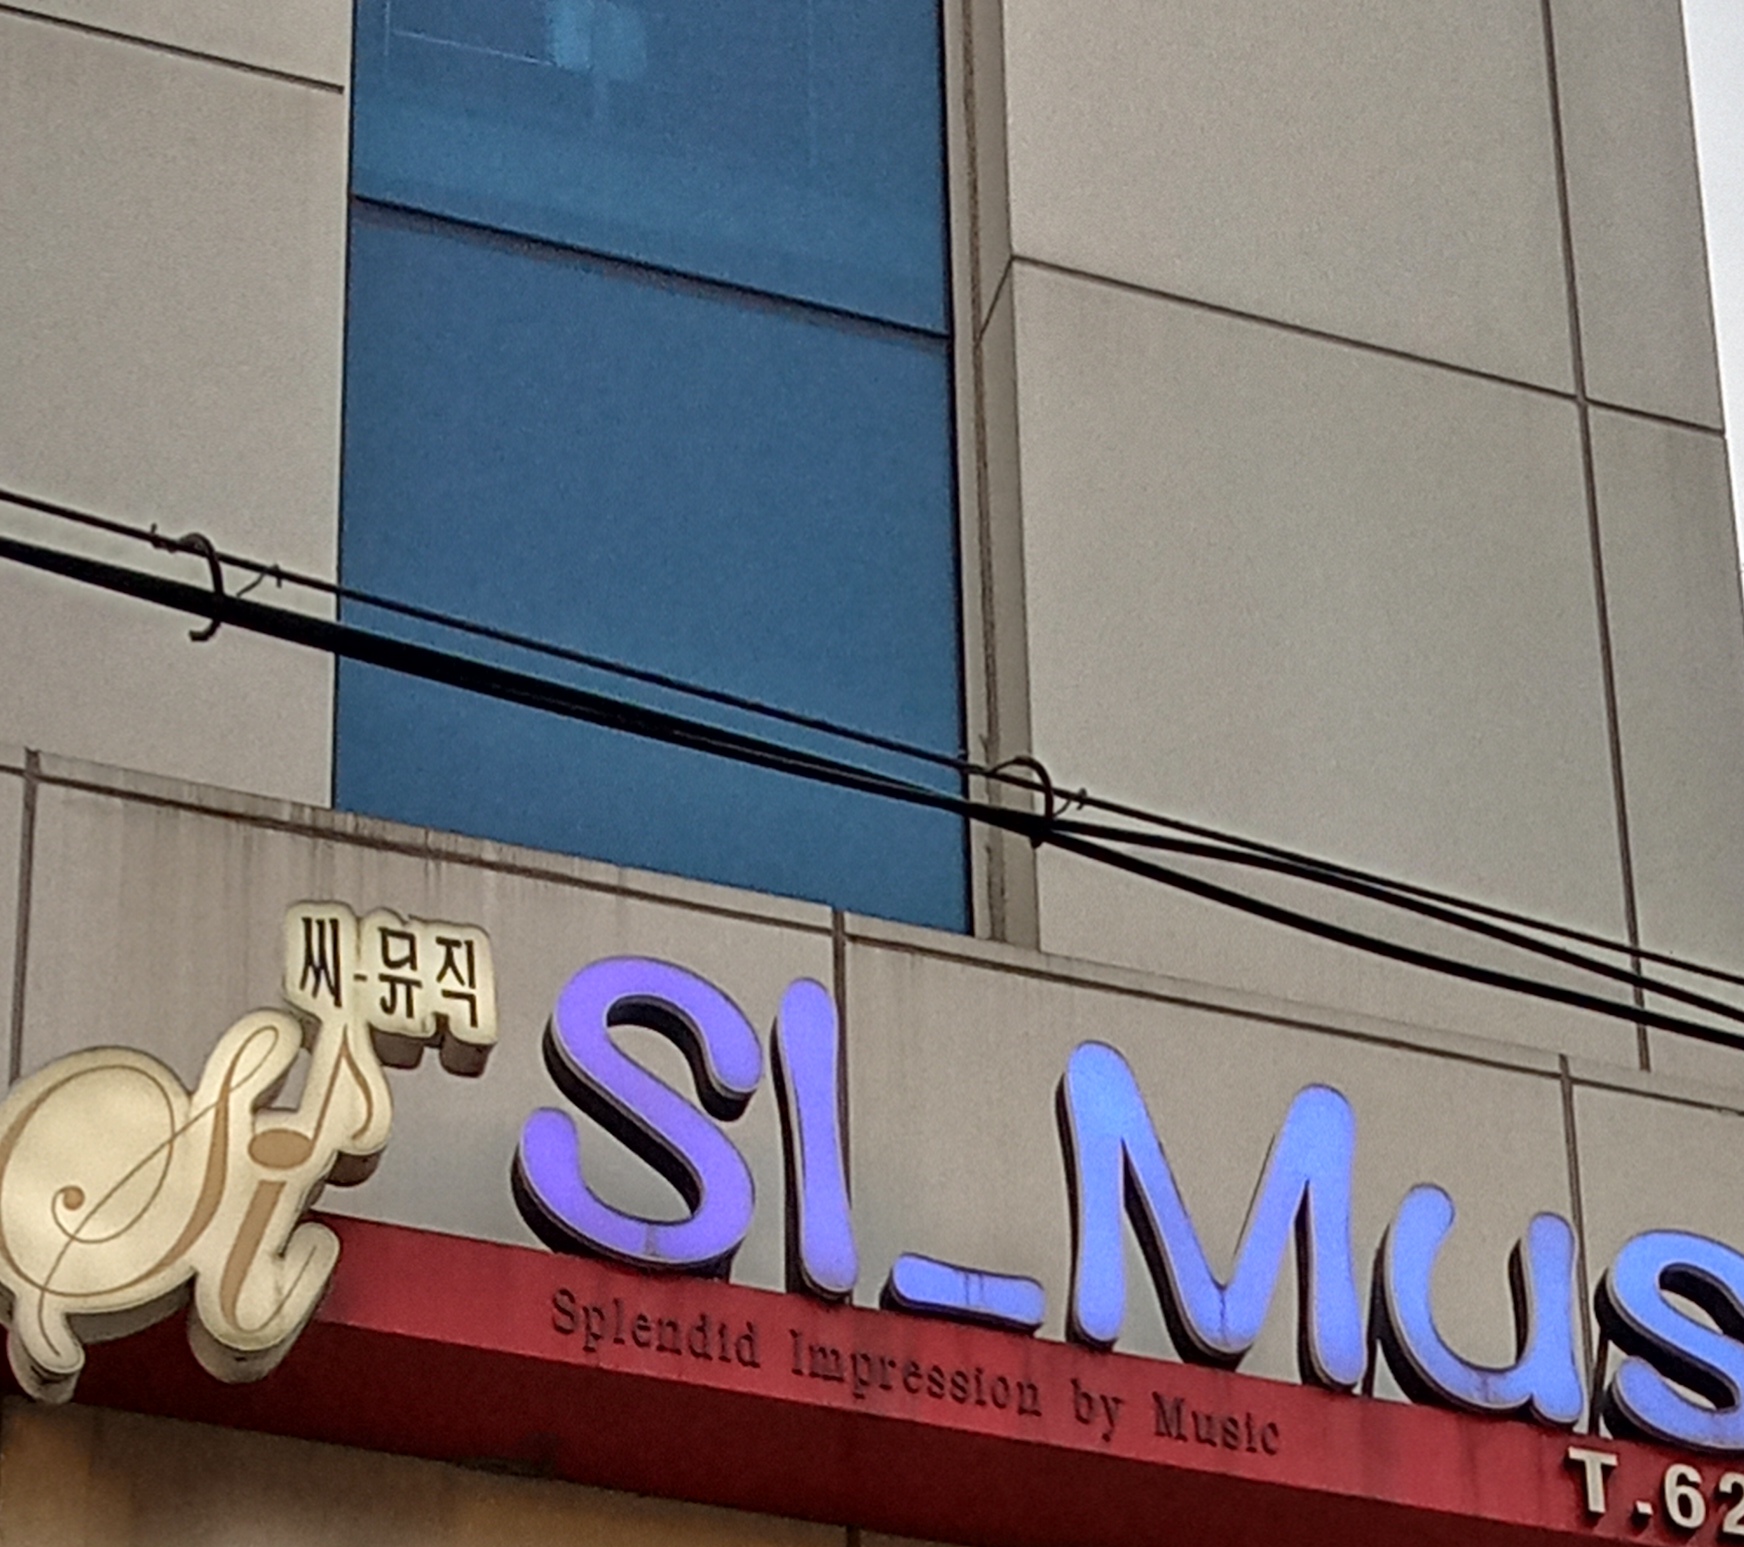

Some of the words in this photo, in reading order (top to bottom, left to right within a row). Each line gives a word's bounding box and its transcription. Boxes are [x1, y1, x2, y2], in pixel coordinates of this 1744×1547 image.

[550, 1287, 763, 1372] Splendid
[790, 1328, 1045, 1418] Impression
[1070, 1378, 1124, 1442] by
[1152, 1392, 1283, 1458] Music
